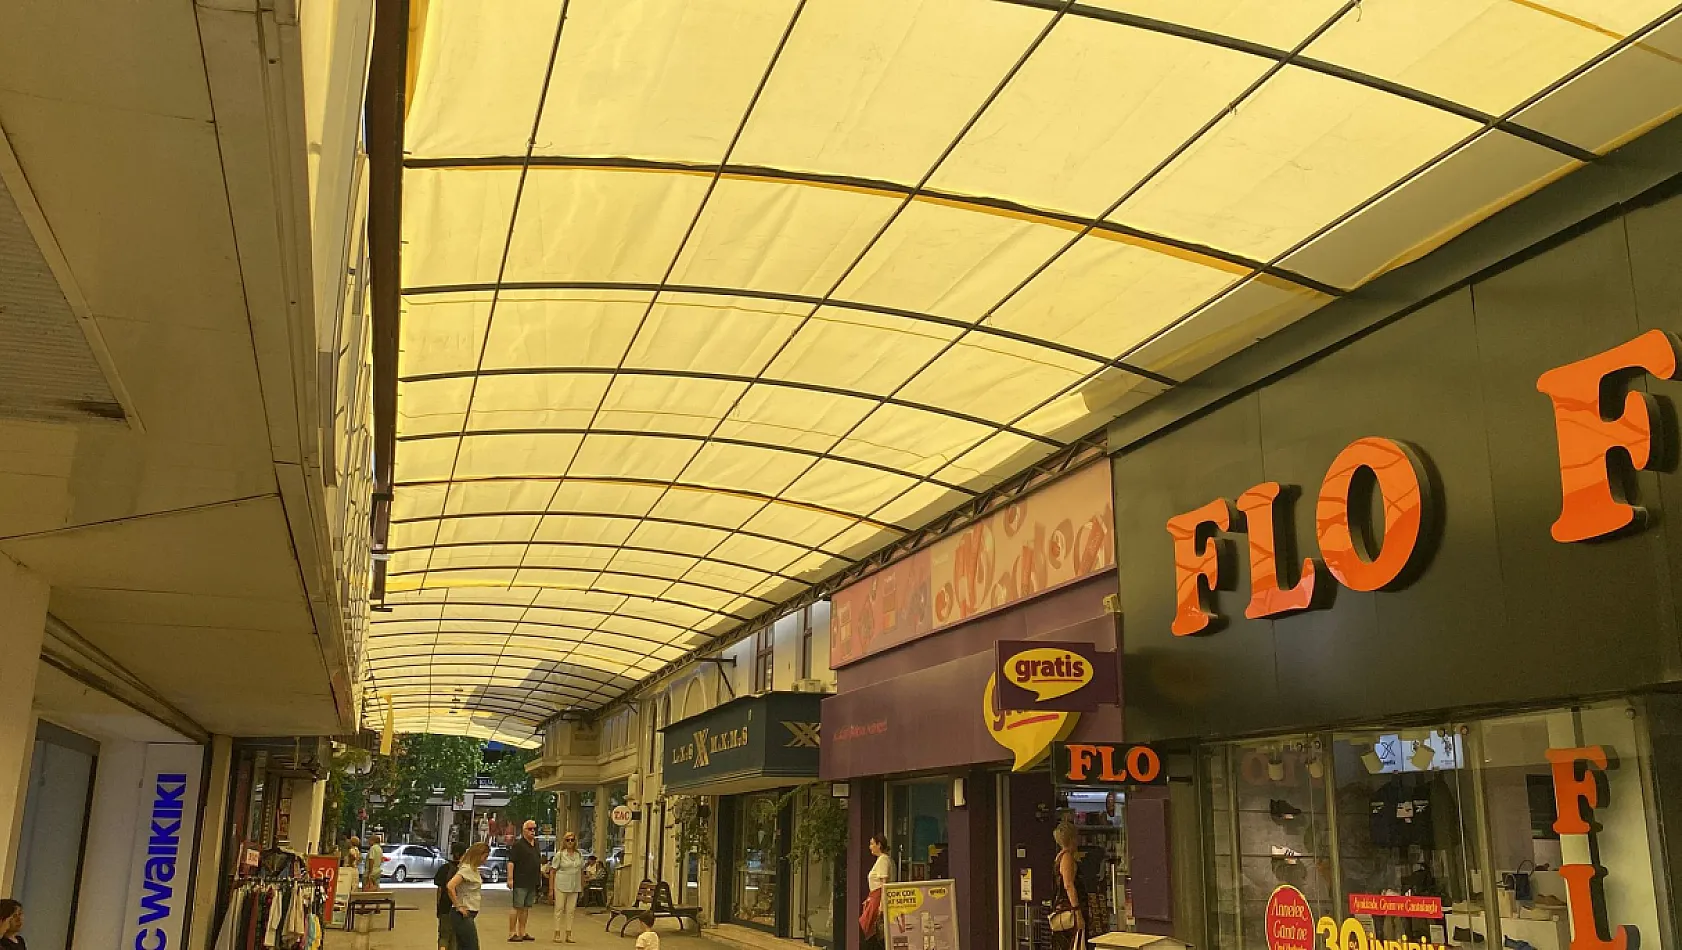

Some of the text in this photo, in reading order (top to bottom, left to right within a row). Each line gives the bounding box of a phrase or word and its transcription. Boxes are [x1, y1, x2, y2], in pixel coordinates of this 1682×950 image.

[1167, 329, 1677, 637] FLO F
[1015, 655, 1085, 683] gratis
[1064, 744, 1161, 782] FLO
[1316, 916, 1368, 950] 30
